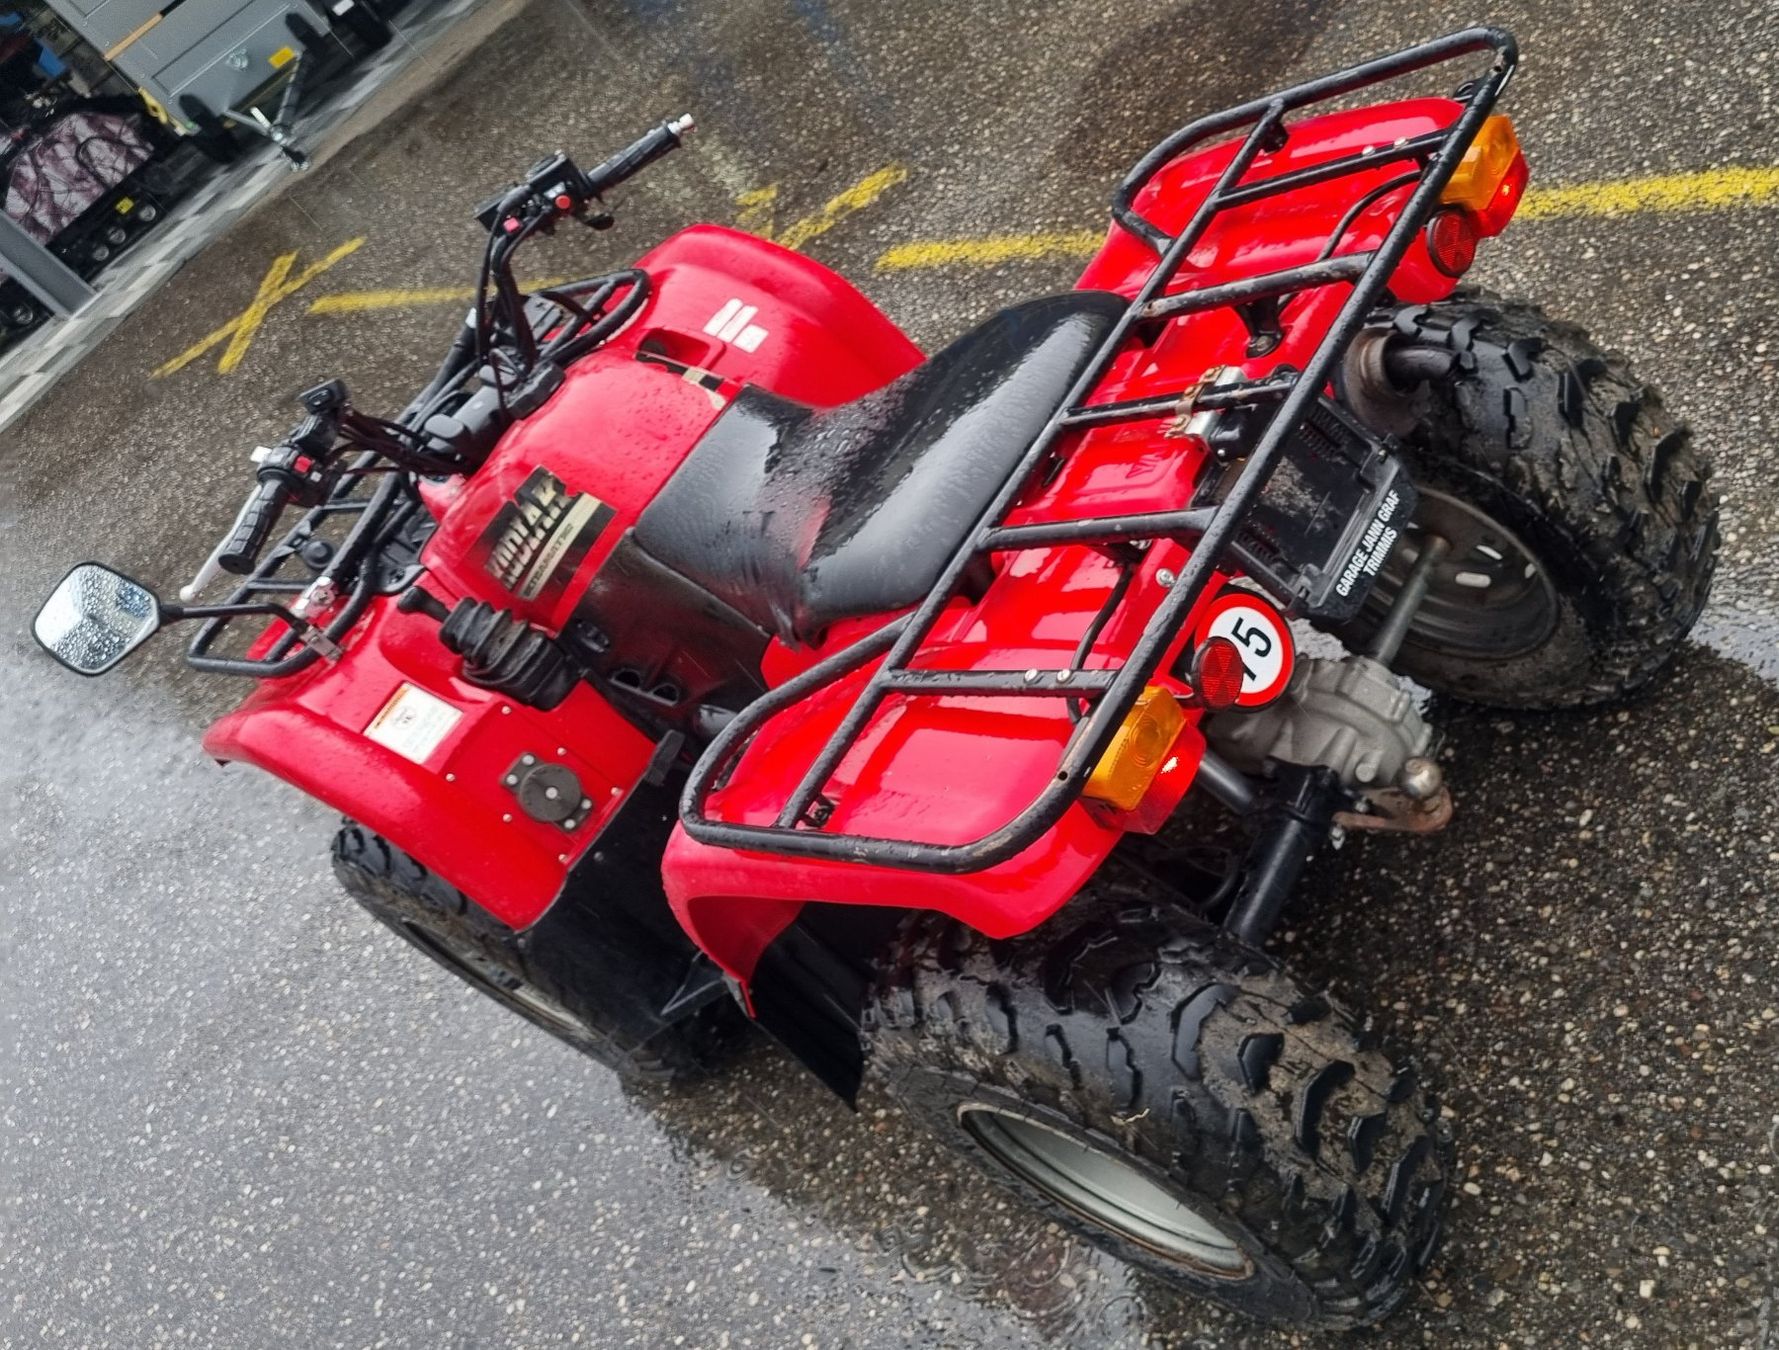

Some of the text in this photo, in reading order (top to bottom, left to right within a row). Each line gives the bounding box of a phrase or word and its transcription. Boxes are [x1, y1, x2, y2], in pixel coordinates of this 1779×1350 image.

[1336, 490, 1401, 597] GARAGE JANN GRAF
[1363, 527, 1398, 577] TRIMMIS
